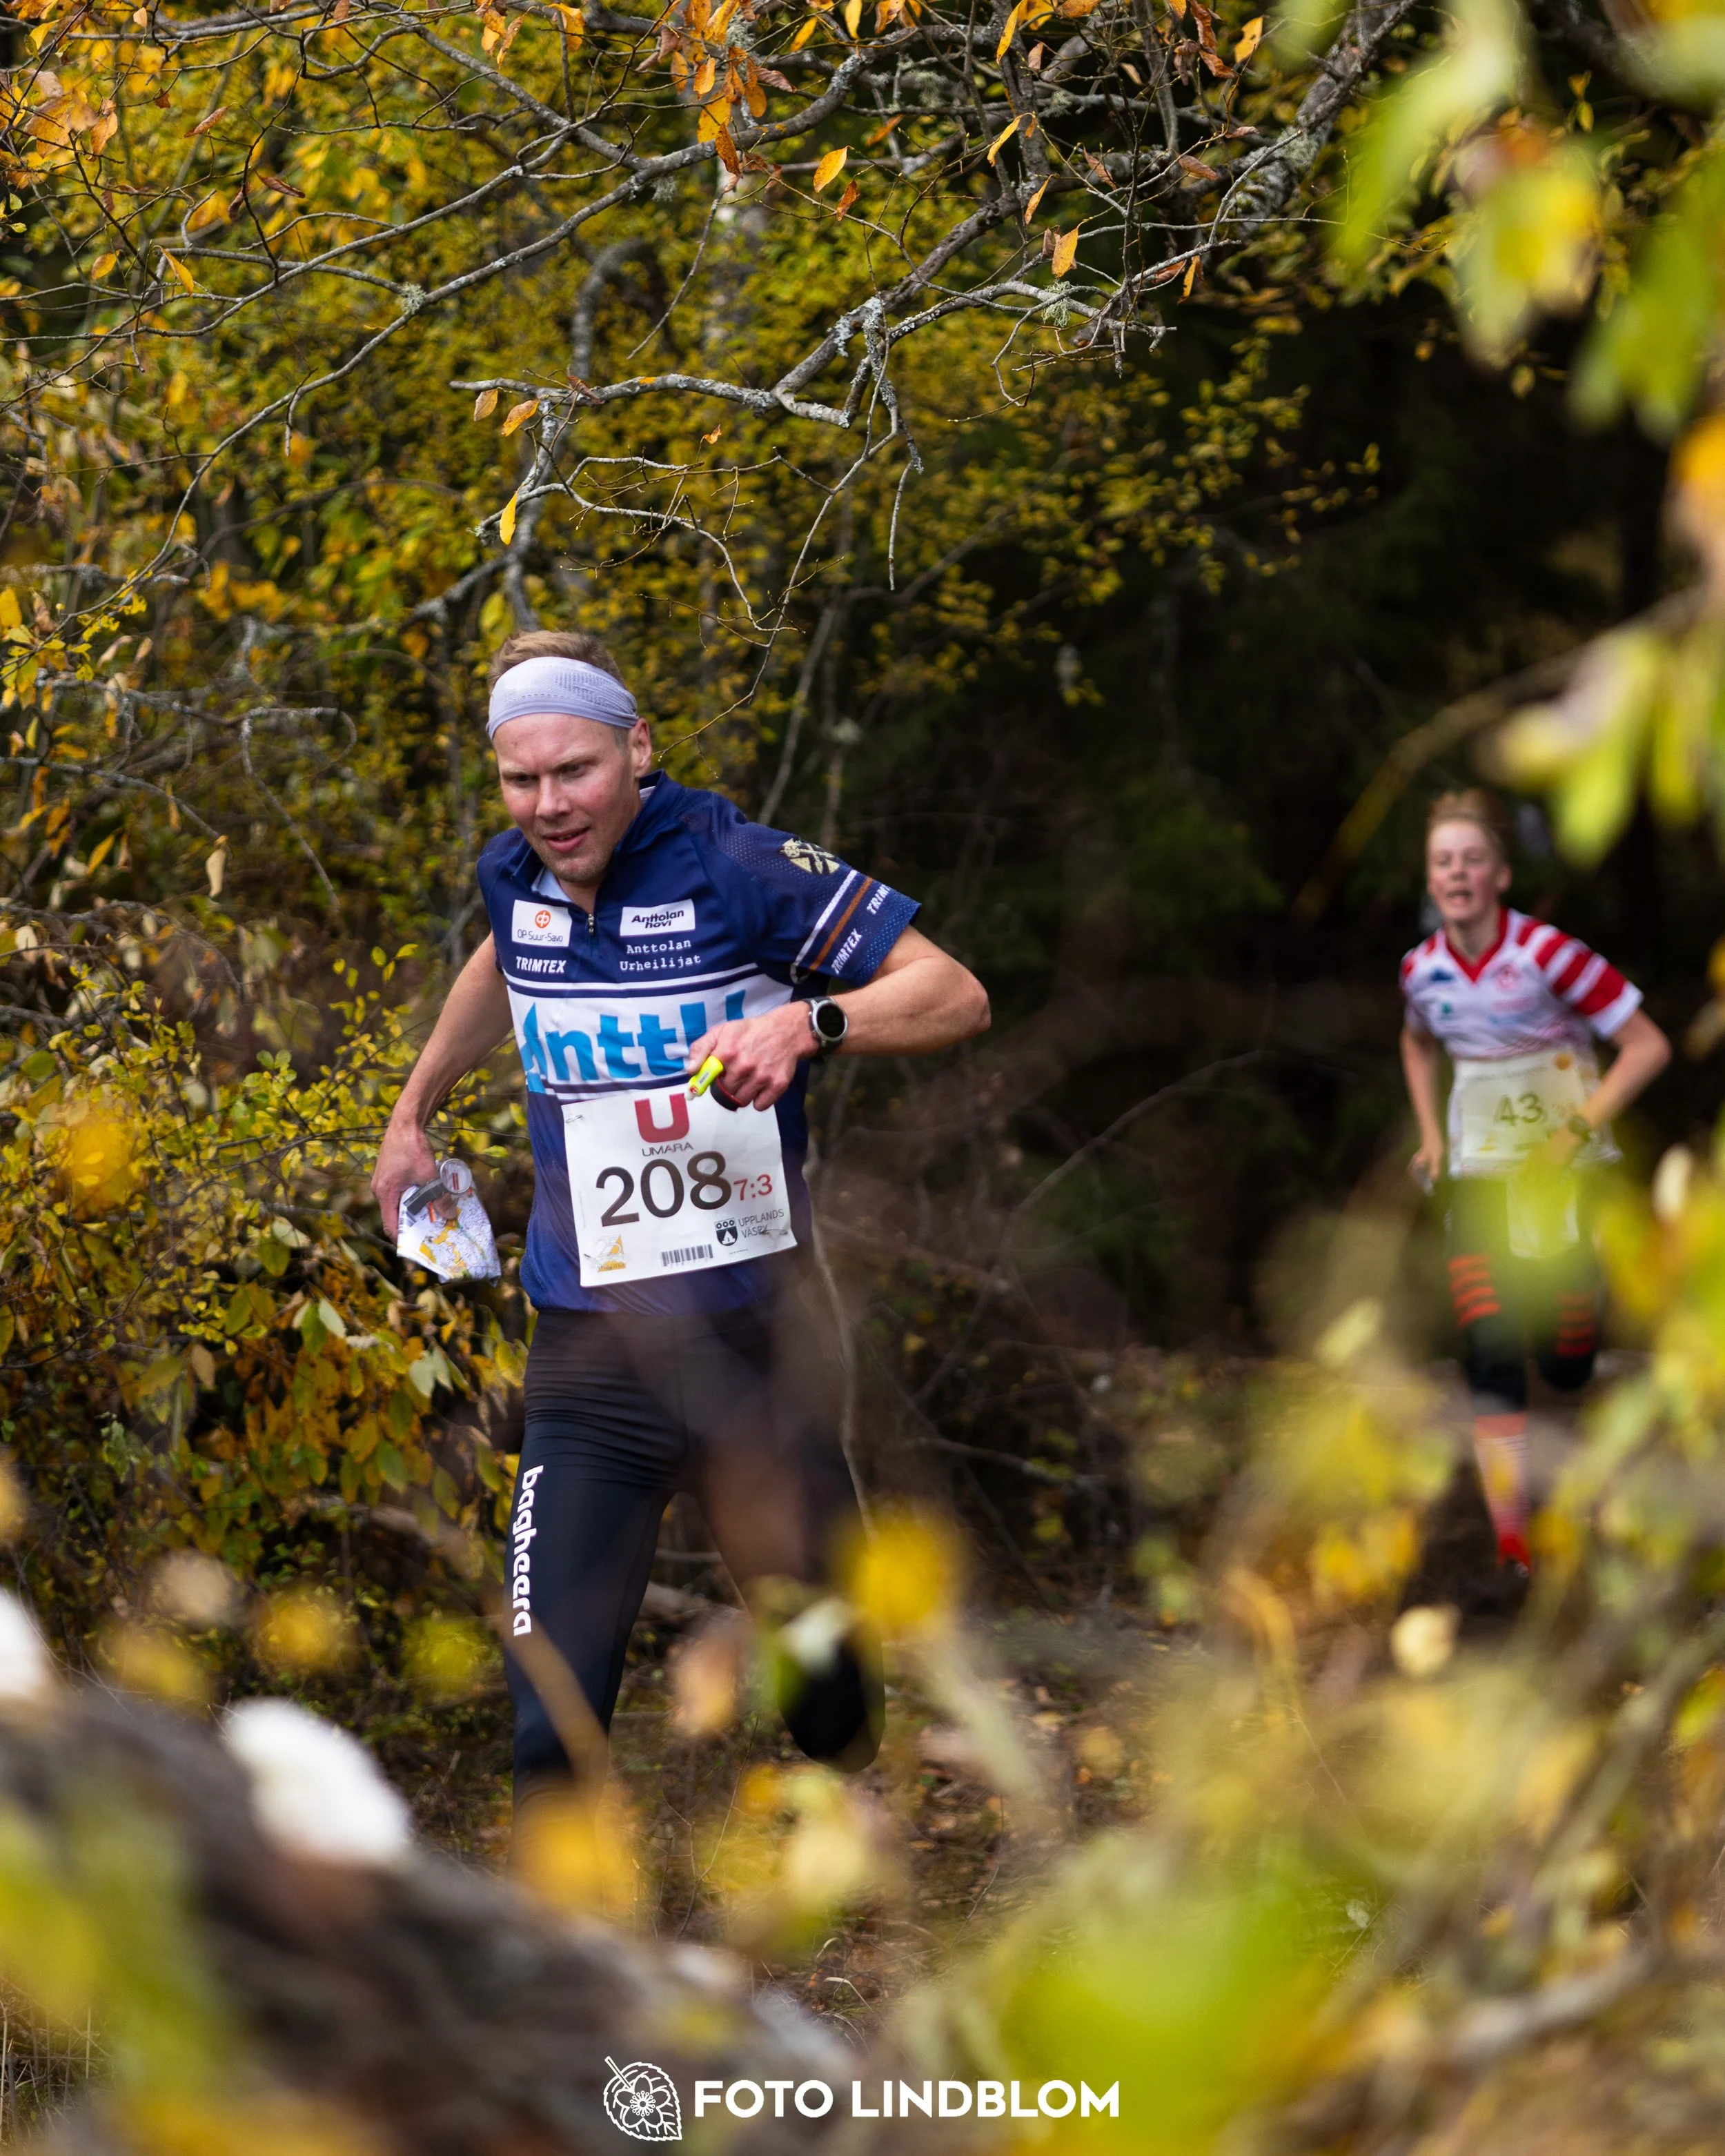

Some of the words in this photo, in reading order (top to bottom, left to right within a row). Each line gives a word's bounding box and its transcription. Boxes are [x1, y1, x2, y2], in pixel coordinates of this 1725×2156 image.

[631, 909, 684, 924] Anttolan
[644, 918, 672, 929] hovi
[517, 929, 527, 938] OP
[529, 931, 564, 942] Suur-Savo
[626, 939, 691, 954] Anttolan
[831, 928, 863, 975] TRIMTEX
[515, 956, 566, 974] TRIMTEX
[620, 954, 702, 972] Urheilijat
[1496, 1092, 1545, 1127] 43
[642, 1142, 694, 1157] UMARA
[595, 1151, 732, 1227] 208
[733, 1174, 773, 1201] 7:3
[738, 1209, 785, 1227] UPPLANDS
[513, 1465, 544, 1636] bagheera
